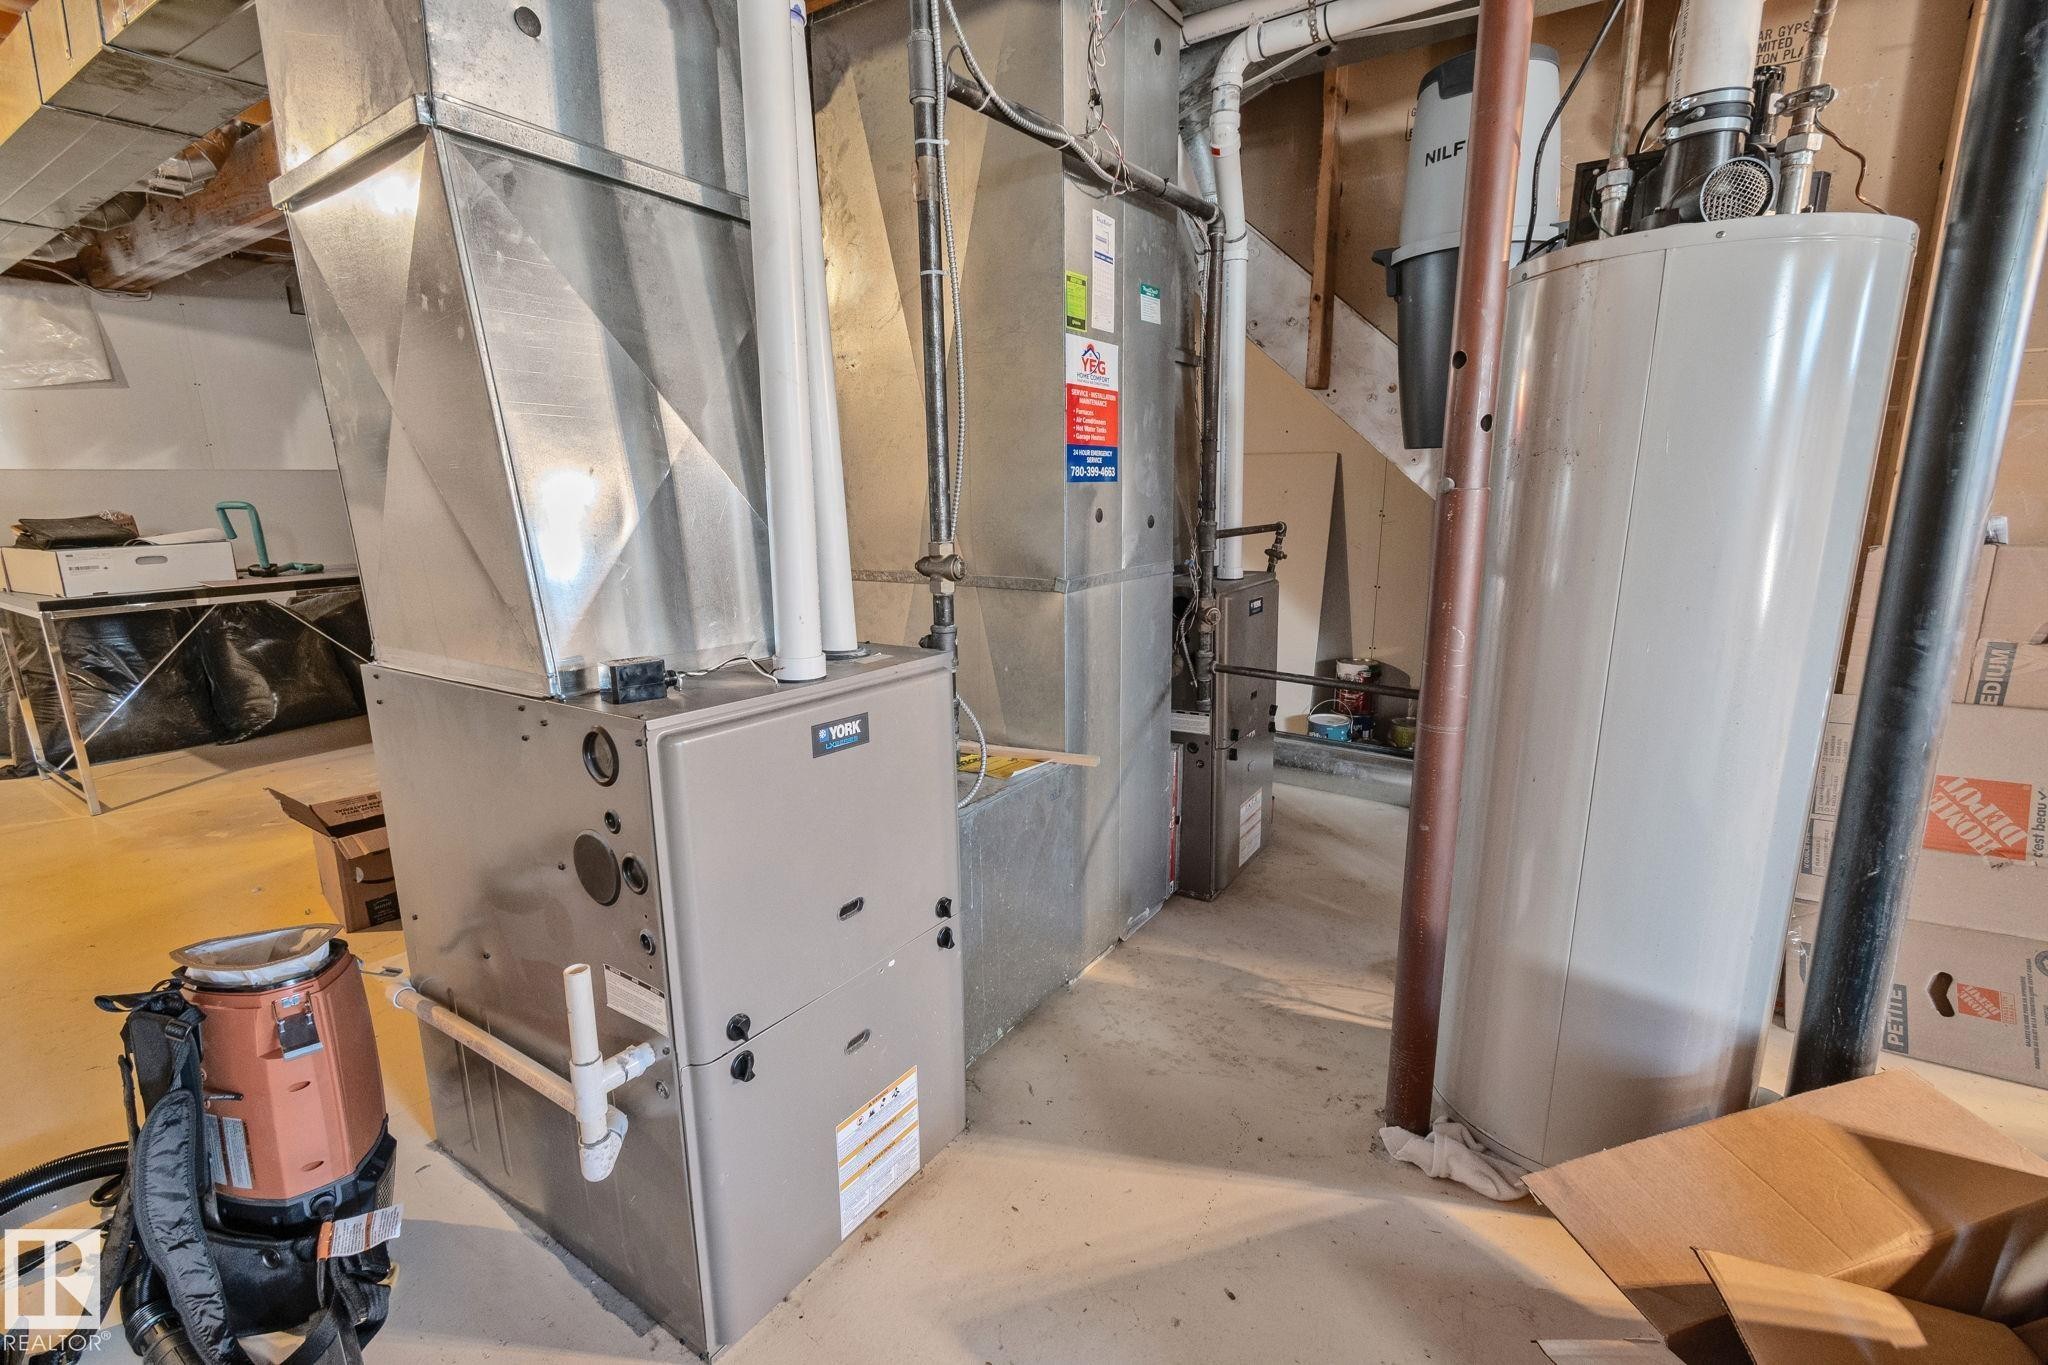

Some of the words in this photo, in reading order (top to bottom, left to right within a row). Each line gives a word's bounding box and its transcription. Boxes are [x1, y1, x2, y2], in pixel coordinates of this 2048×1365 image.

[1778, 20, 1810, 38] GYPS
[1081, 357, 1106, 375] YEG
[1076, 372, 1090, 380] HOME
[1090, 374, 1110, 383] COMFORT
[1071, 388, 1089, 397] SERVICE
[1090, 391, 1117, 401] INSTALLATION
[1078, 397, 1108, 408] MAINTENANCE
[1075, 424, 1083, 432] Hot
[1075, 433, 1090, 441] Garage
[1086, 456, 1103, 464] SERVICE
[1091, 449, 1113, 457] EMERGENCY
[1979, 650, 2010, 705] EDIUM
[829, 719, 861, 740] YORK
[1940, 777, 2028, 848] DEPOT
[2030, 803, 2047, 832] beau
[1929, 792, 2002, 855] HOME
[2032, 832, 2045, 859] c'est
[1887, 987, 1904, 1047] PETITE
